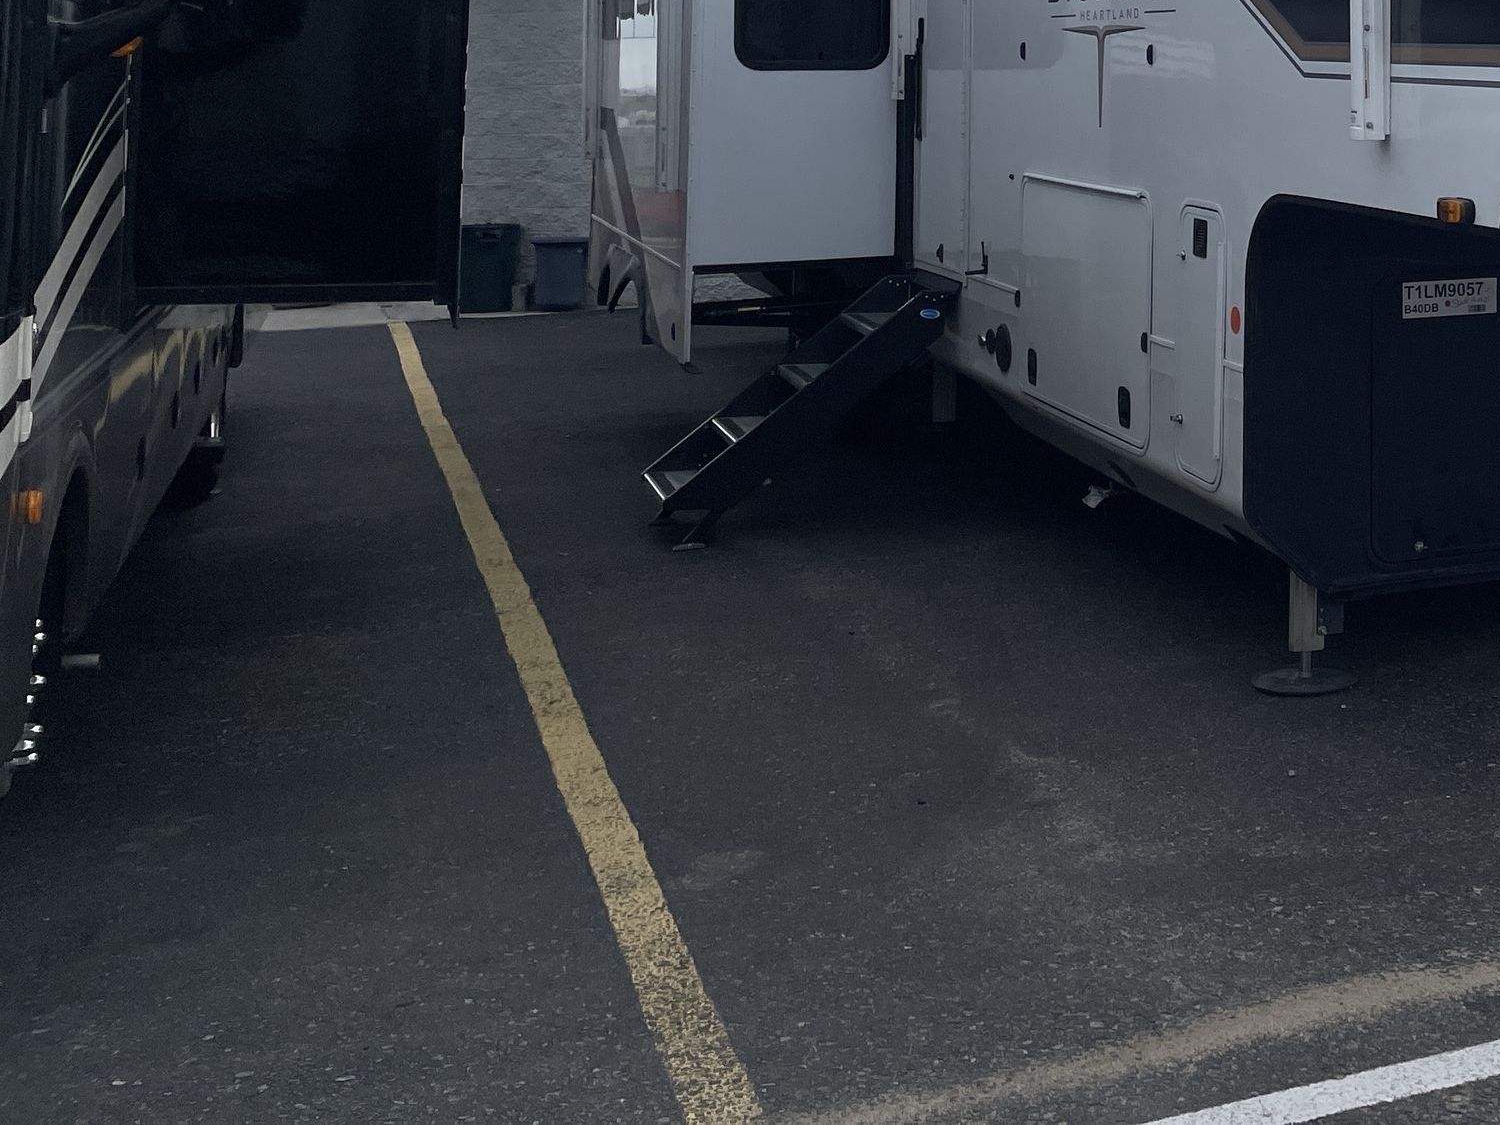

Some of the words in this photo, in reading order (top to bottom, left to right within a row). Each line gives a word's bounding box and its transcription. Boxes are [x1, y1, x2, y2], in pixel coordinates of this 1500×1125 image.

[1080, 8, 1140, 21] HEARTLAND
[1404, 282, 1484, 300] T1LM9057
[1404, 303, 1439, 315] B40DB
